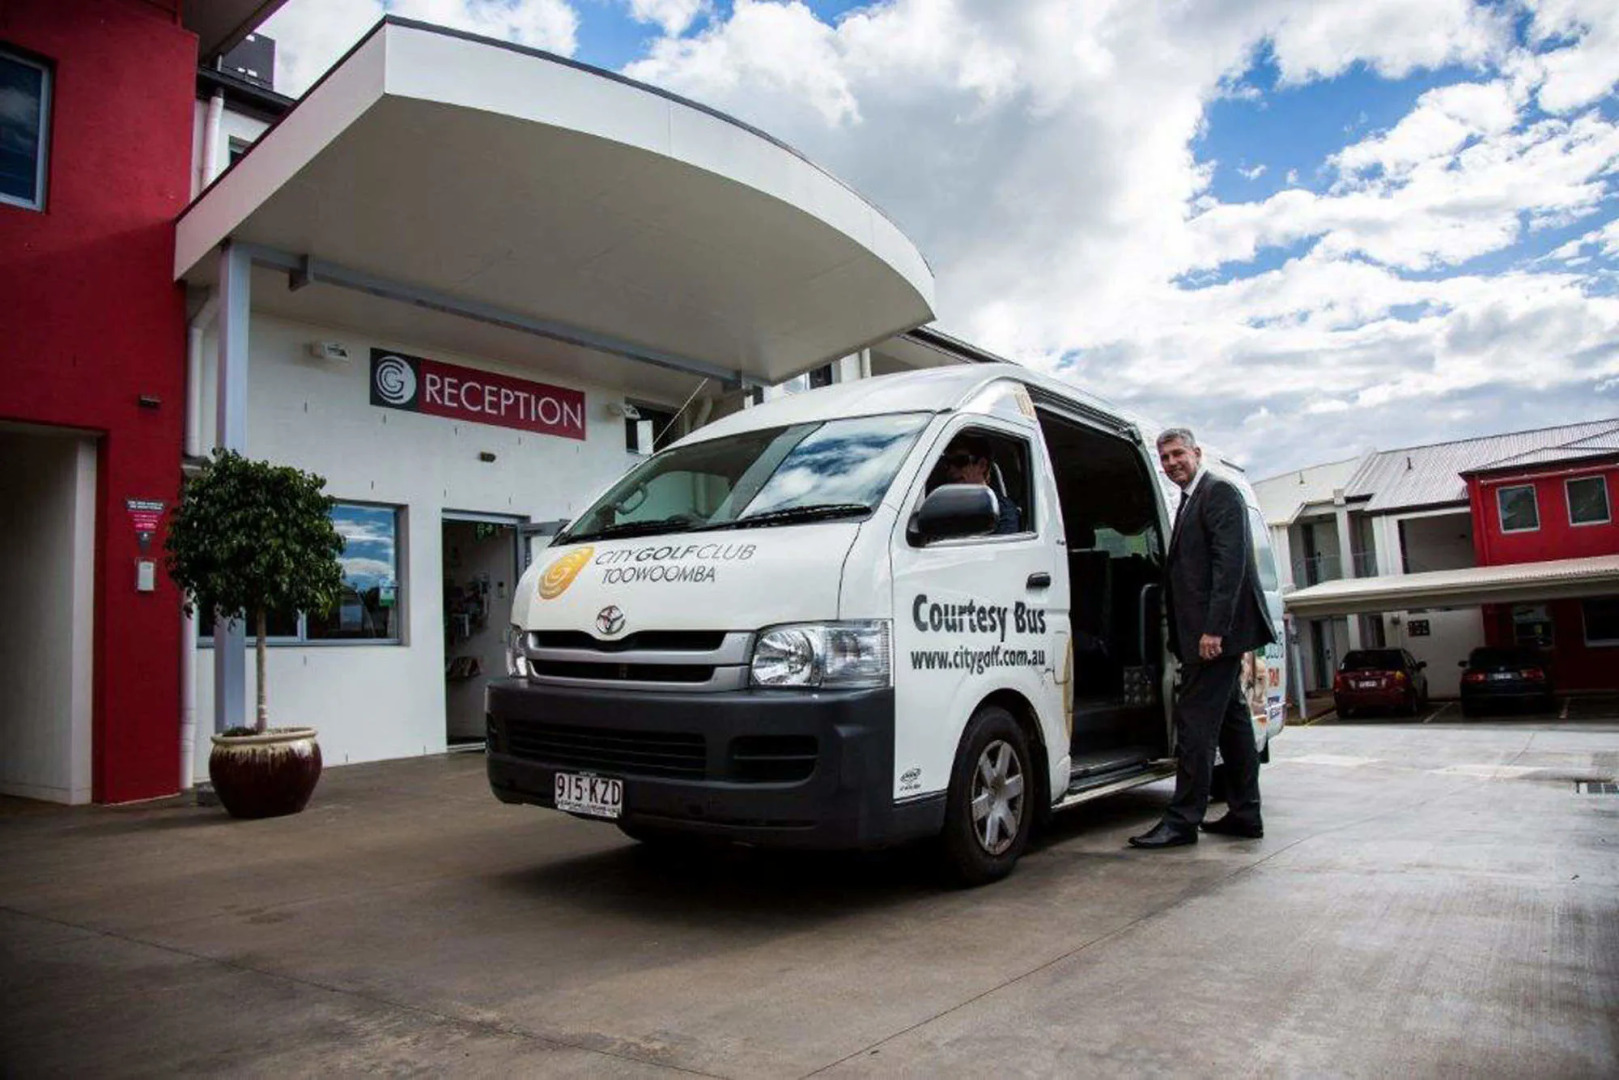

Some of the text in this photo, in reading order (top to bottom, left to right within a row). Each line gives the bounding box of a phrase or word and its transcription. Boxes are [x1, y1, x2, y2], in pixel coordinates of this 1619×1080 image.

[425, 373, 583, 429] RECEPTION
[602, 565, 716, 584] TOOWOOMBA
[912, 593, 1047, 643] Courtesy Bus
[910, 645, 1046, 675] www.citygolf.com.au
